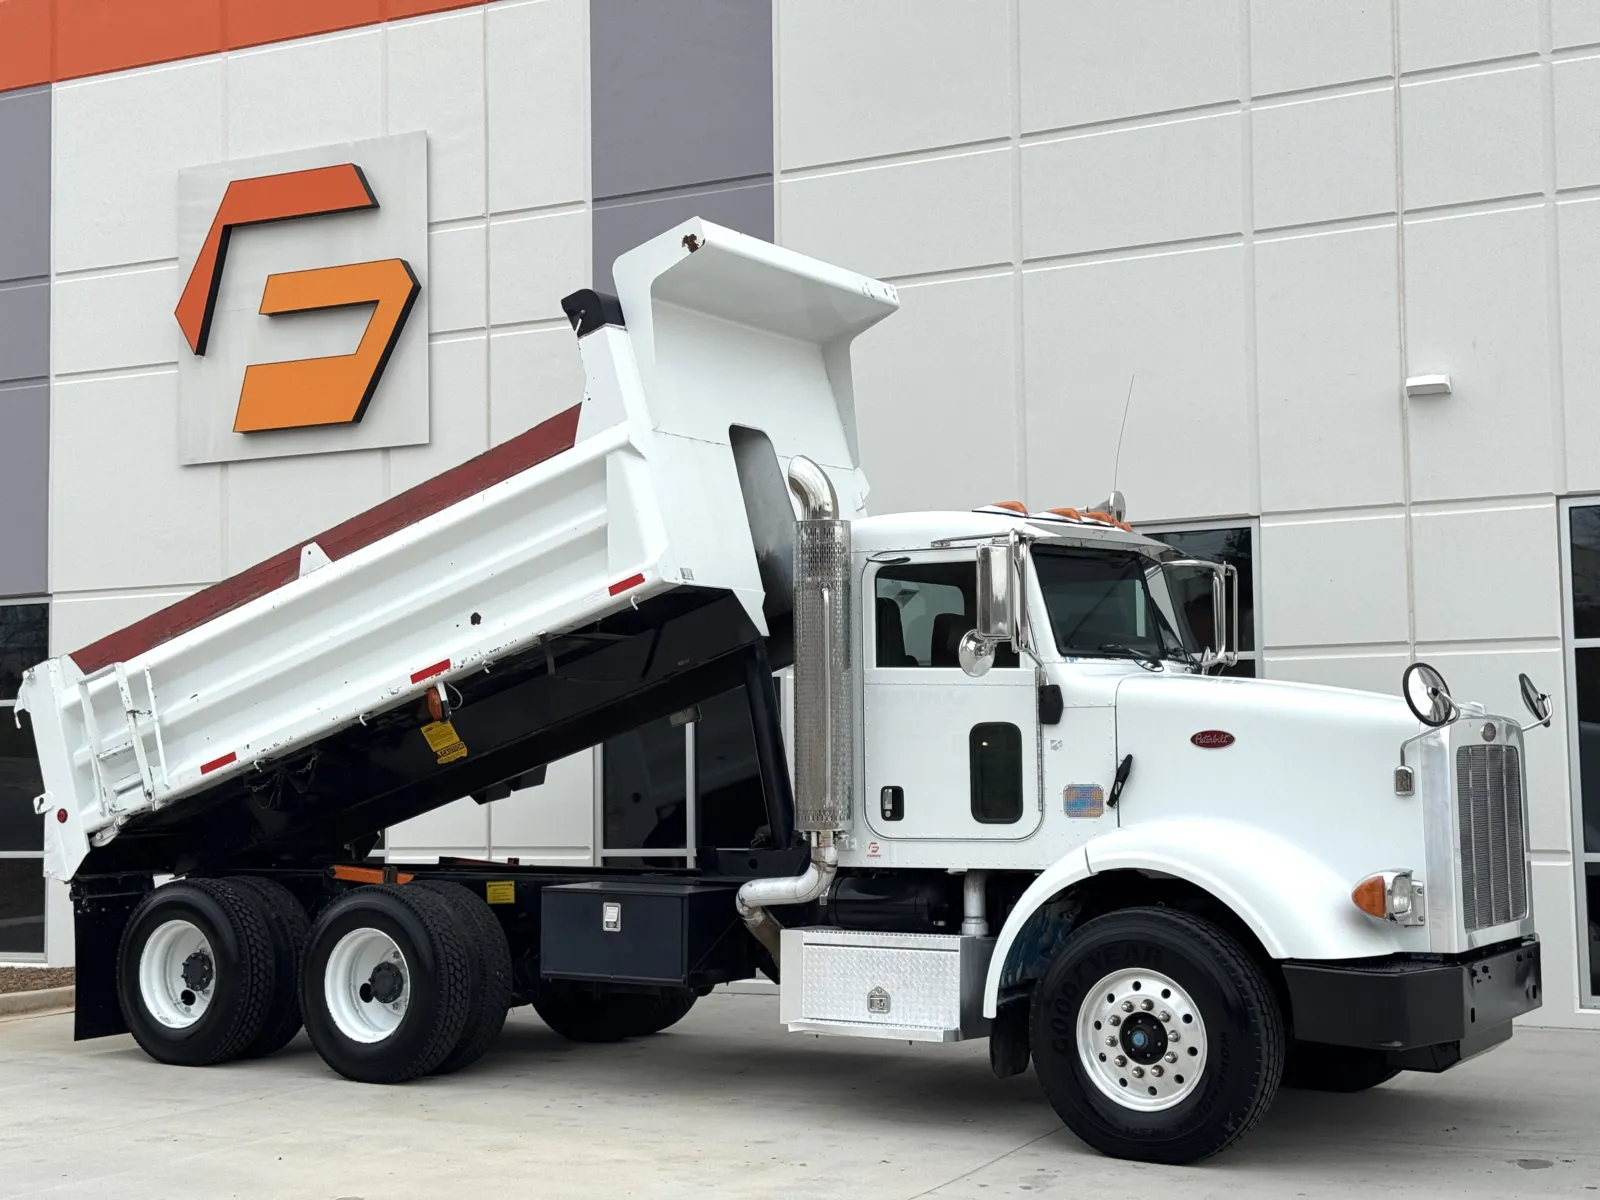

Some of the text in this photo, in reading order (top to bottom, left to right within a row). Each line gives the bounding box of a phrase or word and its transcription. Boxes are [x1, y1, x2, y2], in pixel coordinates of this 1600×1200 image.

[1194, 733, 1231, 745] Peterbilt
[440, 742, 465, 758] CAUTION
[1051, 944, 1162, 1055] GOODYEAR
